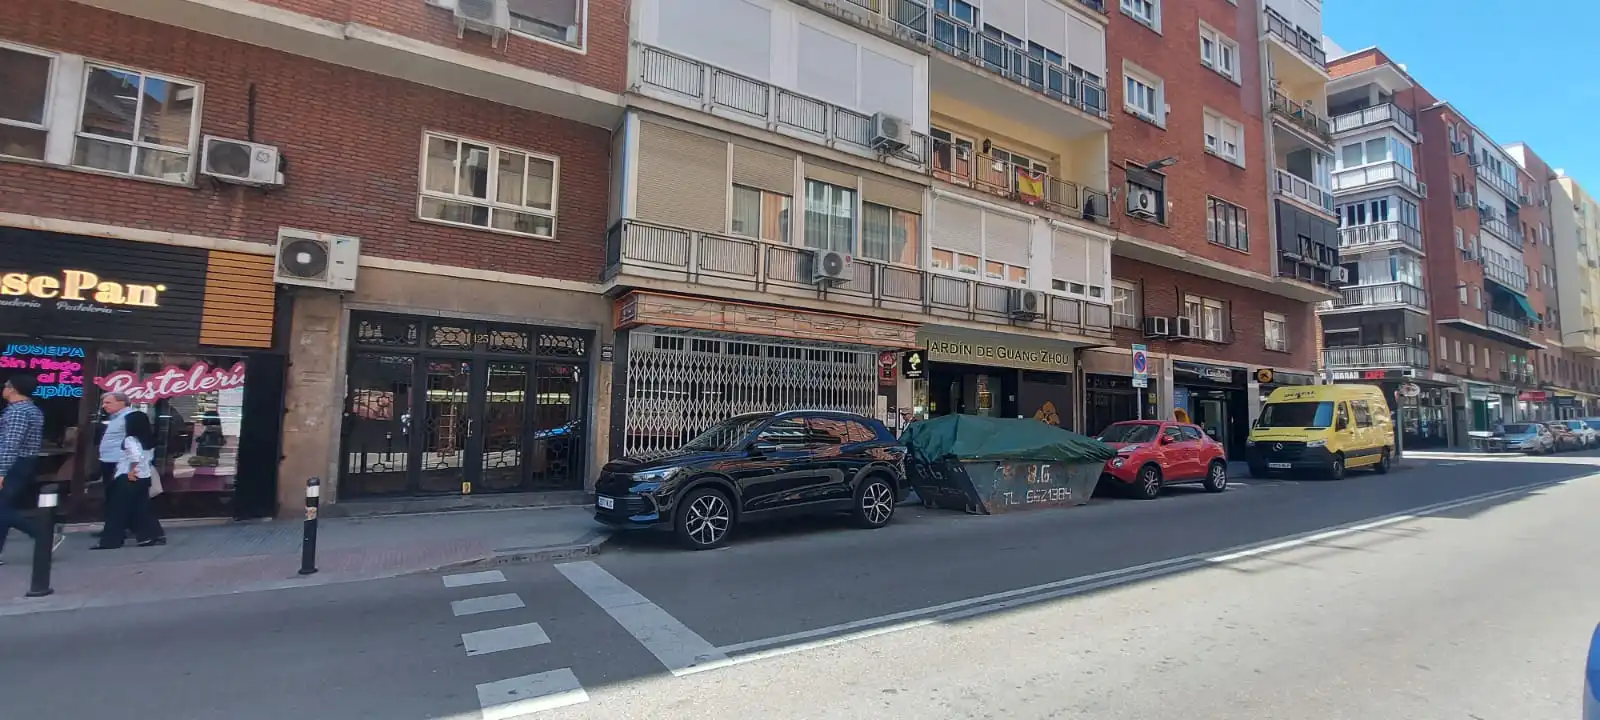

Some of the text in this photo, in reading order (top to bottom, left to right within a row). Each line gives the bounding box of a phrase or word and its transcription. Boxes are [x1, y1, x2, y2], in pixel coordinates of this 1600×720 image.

[0, 269, 161, 307] sePan
[2, 343, 87, 358] JOSEPA
[925, 339, 1069, 366] JARDÍN DE GUANG ZHOU
[36, 372, 55, 383] al
